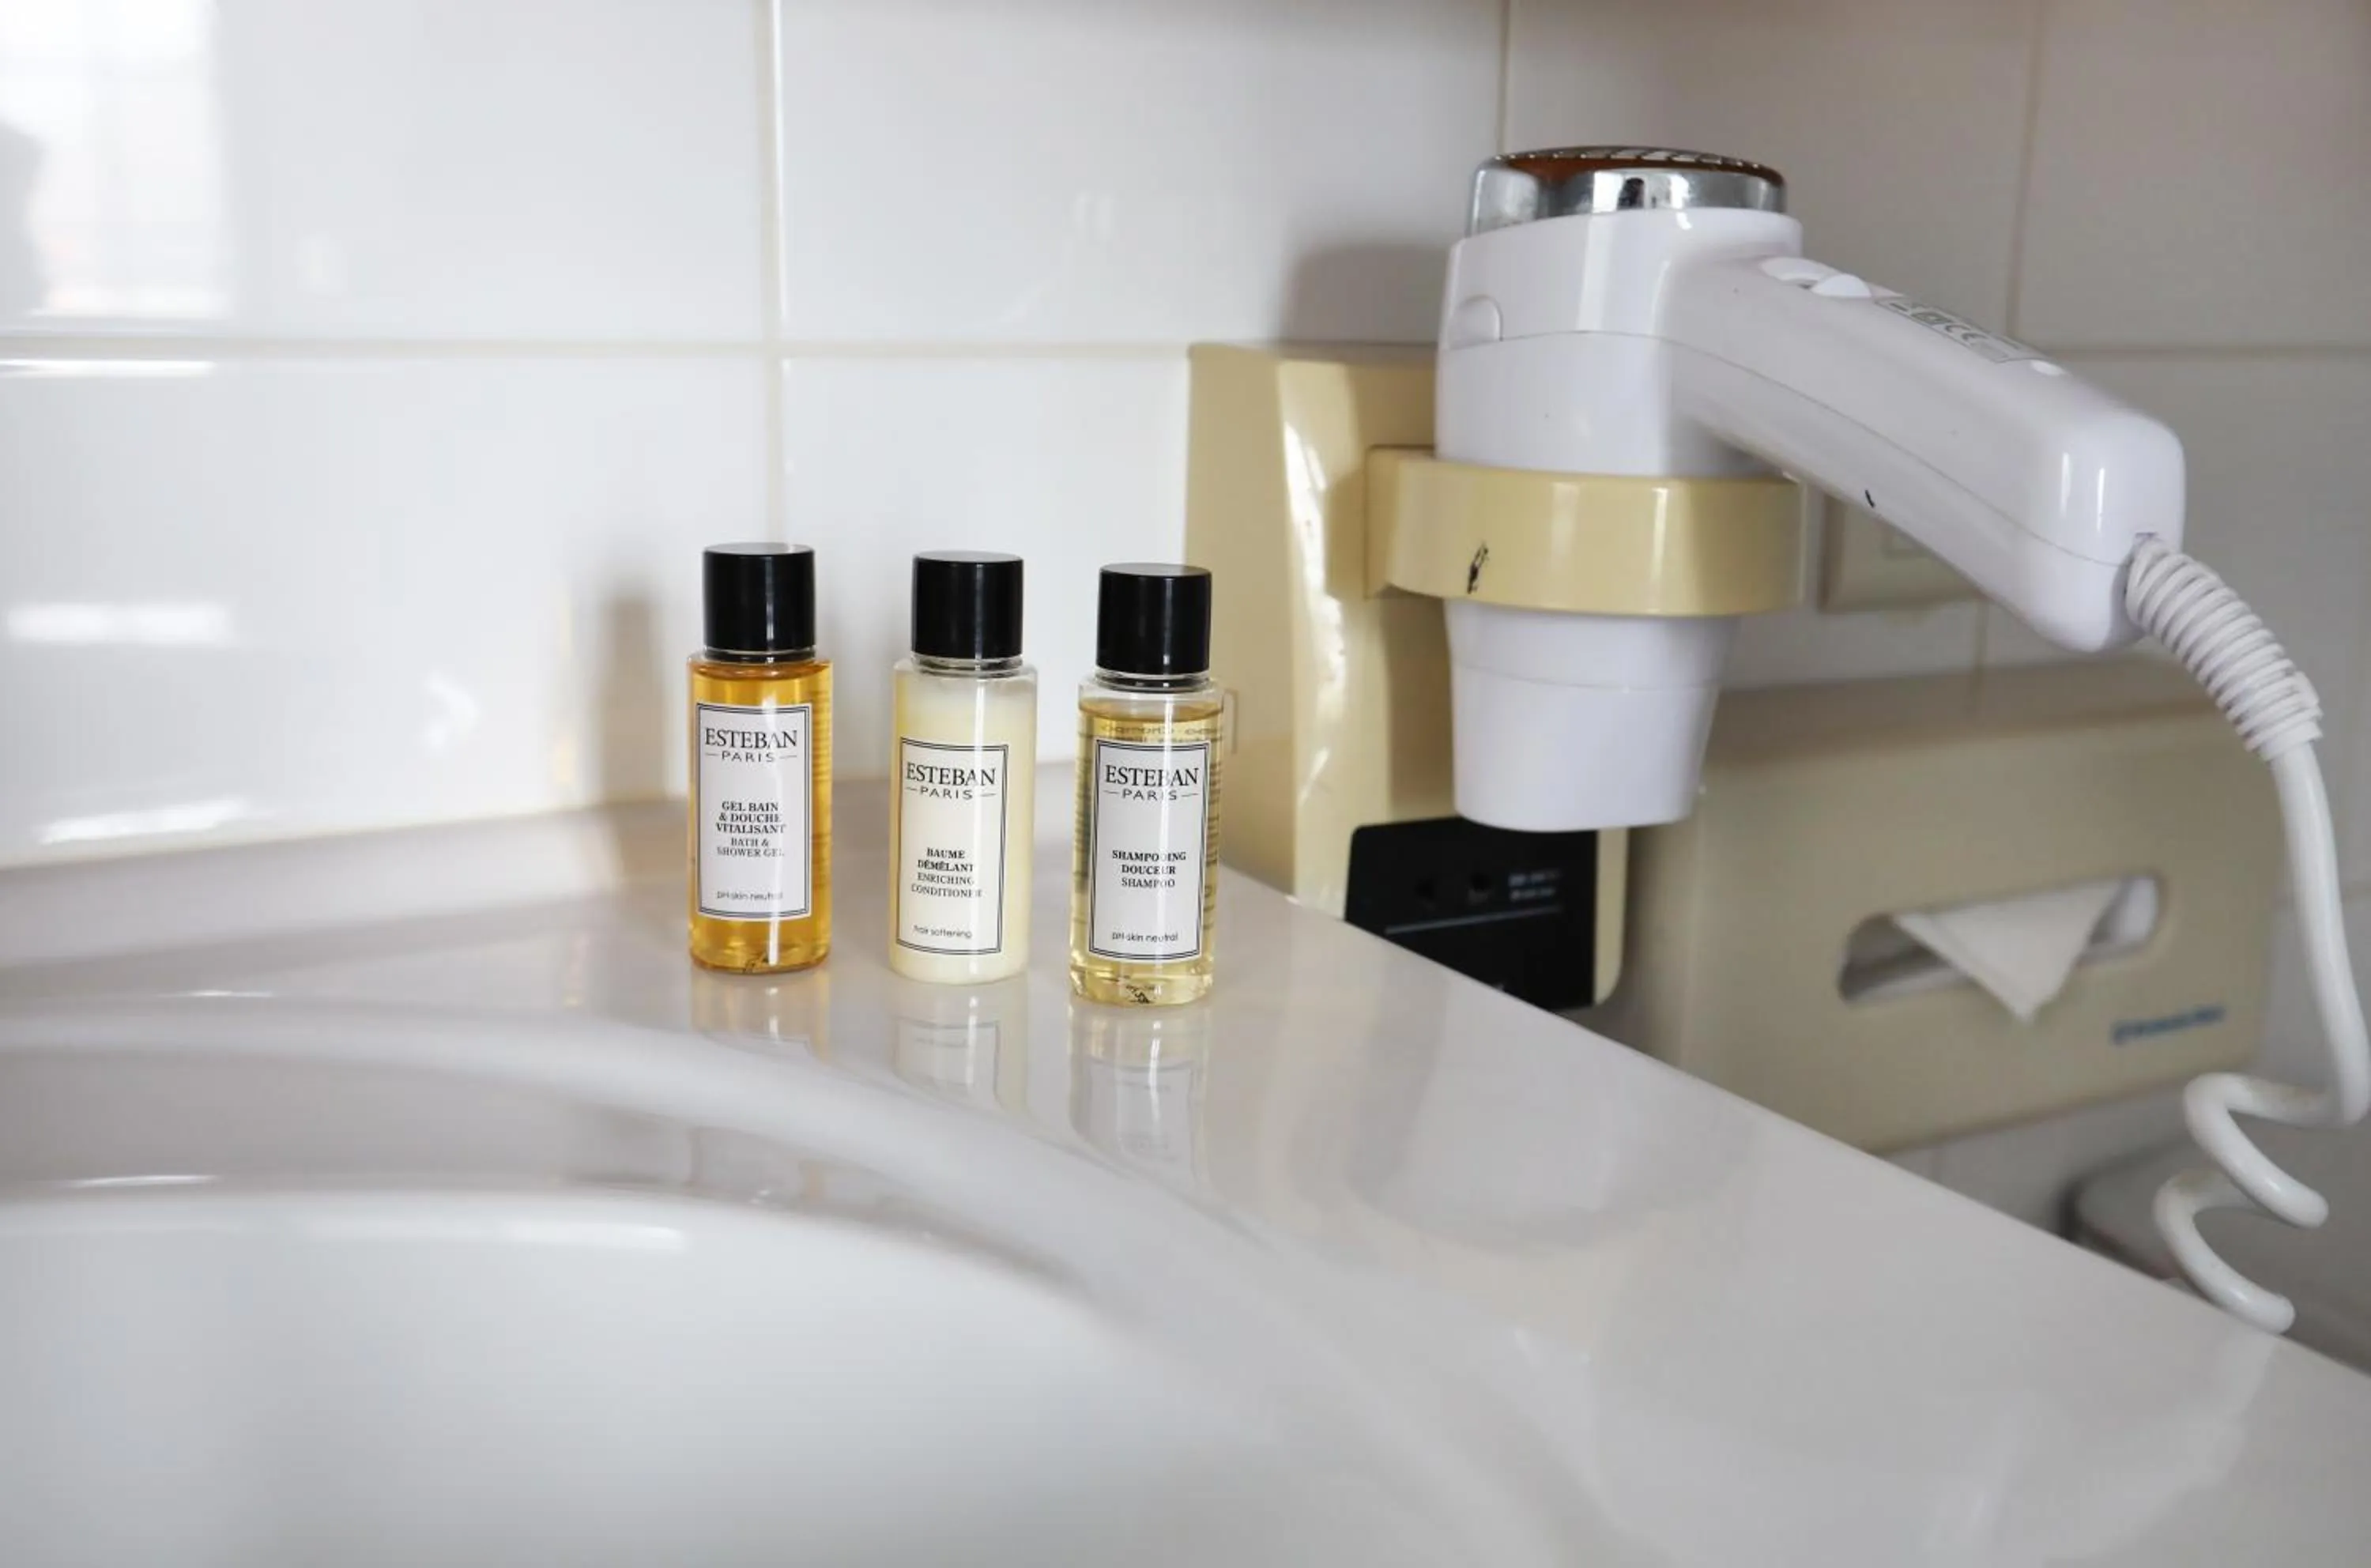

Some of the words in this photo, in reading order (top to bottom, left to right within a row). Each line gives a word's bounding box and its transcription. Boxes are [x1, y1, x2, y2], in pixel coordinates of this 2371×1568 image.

[704, 727, 798, 748] ESTEBAN
[721, 751, 775, 763] PARIS
[906, 762, 996, 786] ESTEBAN
[1105, 764, 1199, 787] ESTEBAN
[920, 787, 974, 800] PARIS
[1121, 789, 1178, 801] PARIS
[722, 801, 746, 812] GEL
[748, 802, 778, 812] BAIN
[718, 812, 727, 822] &
[730, 813, 781, 823] DOUCHE
[716, 823, 787, 834] VITALISANT
[731, 837, 759, 846] BATH
[761, 838, 769, 846] &
[717, 846, 761, 858] SHOWER
[926, 847, 966, 859] BAUME
[1112, 850, 1186, 862] SHAMPOOING
[918, 858, 974, 873] DÉMÊLANT
[1121, 865, 1177, 875] DOUCEUR
[917, 872, 974, 884] ENRICHING
[1121, 878, 1175, 888] SHAMPOO
[930, 927, 973, 939] softening
